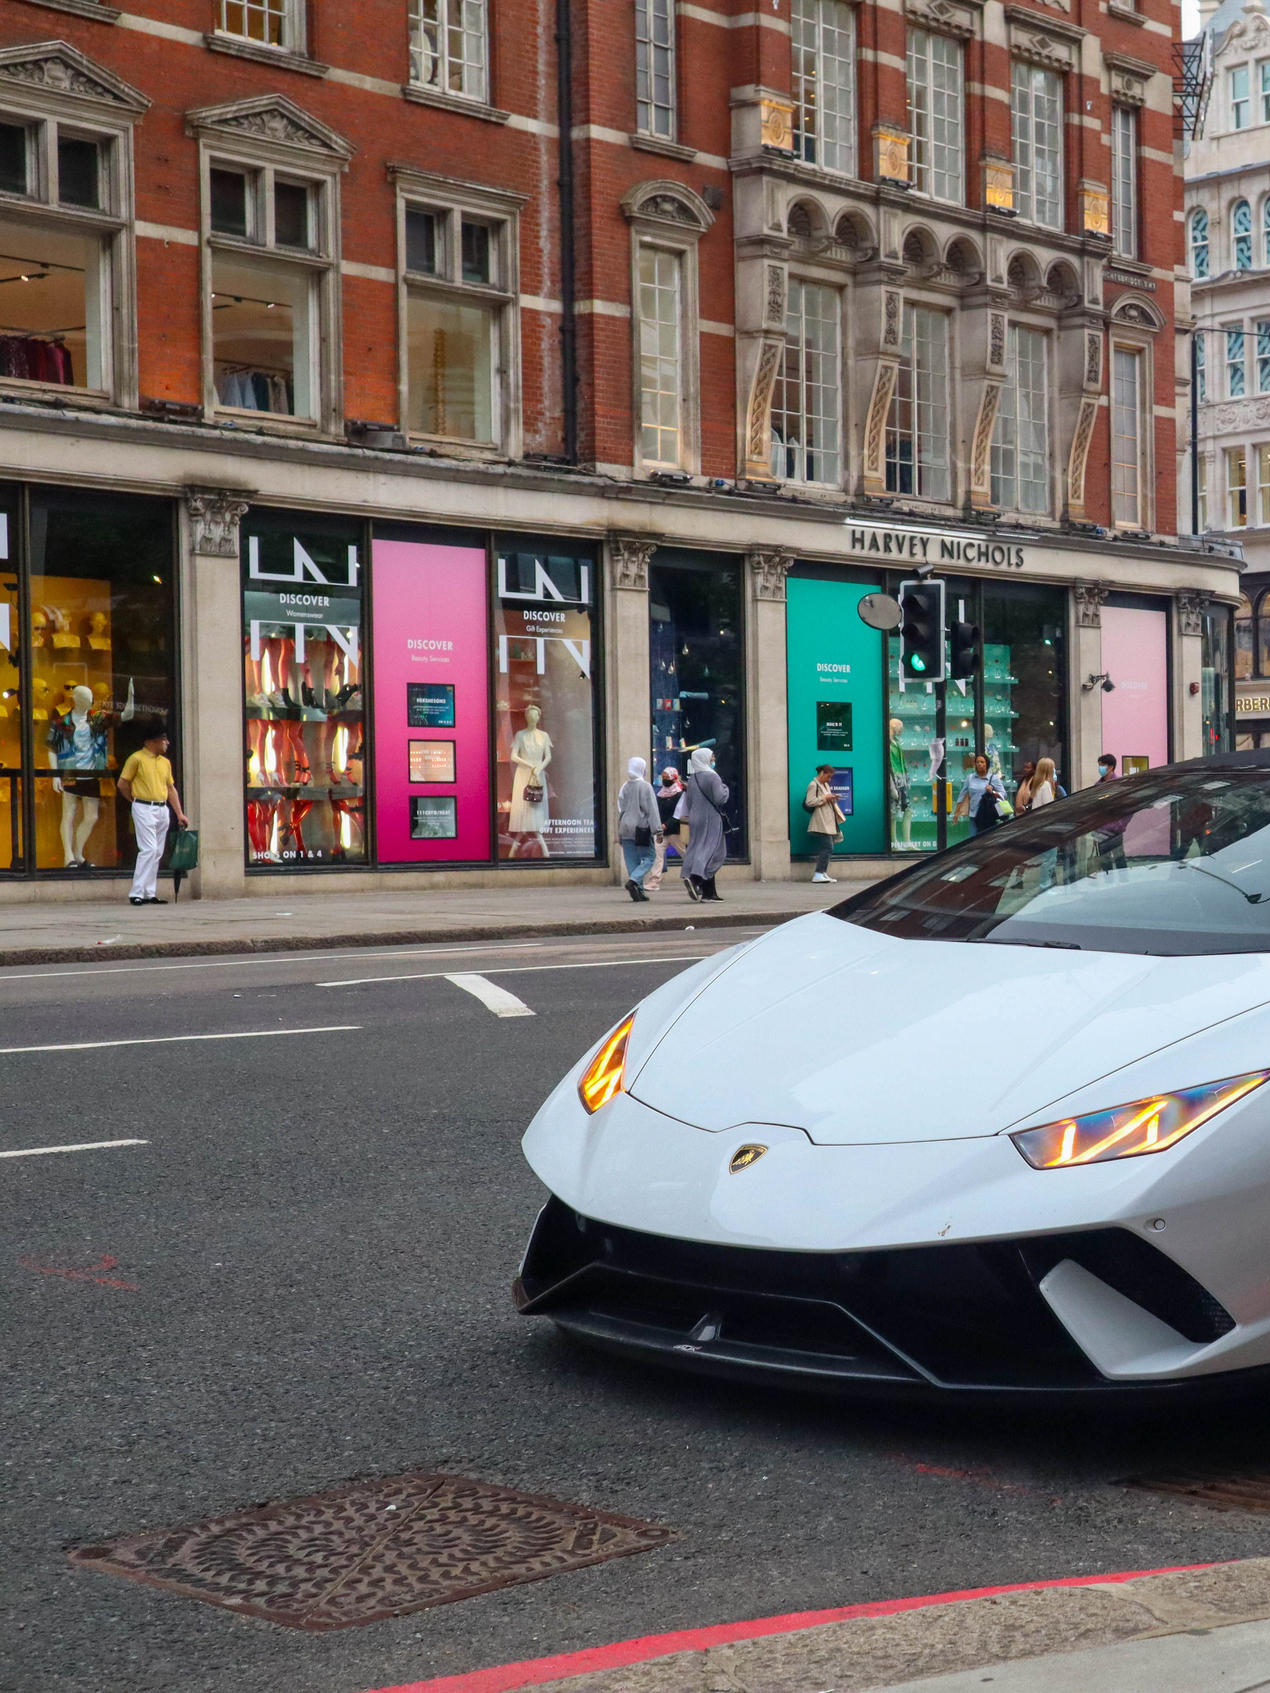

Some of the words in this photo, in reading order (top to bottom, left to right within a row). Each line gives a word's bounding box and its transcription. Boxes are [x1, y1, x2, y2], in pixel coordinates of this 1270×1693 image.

[851, 529, 930, 557] HARVEY
[940, 538, 1025, 567] NICHOLS
[279, 593, 330, 607] DISCOVER
[285, 609, 324, 619] Womenswear
[523, 610, 566, 622] DISCOVER
[536, 625, 563, 634] Experiences
[407, 639, 454, 651] DISCOVER
[429, 654, 450, 663] Services
[816, 662, 851, 673] DISCOVER
[252, 851, 280, 859] SHOS
[283, 850, 296, 859] ON
[307, 850, 314, 858] &
